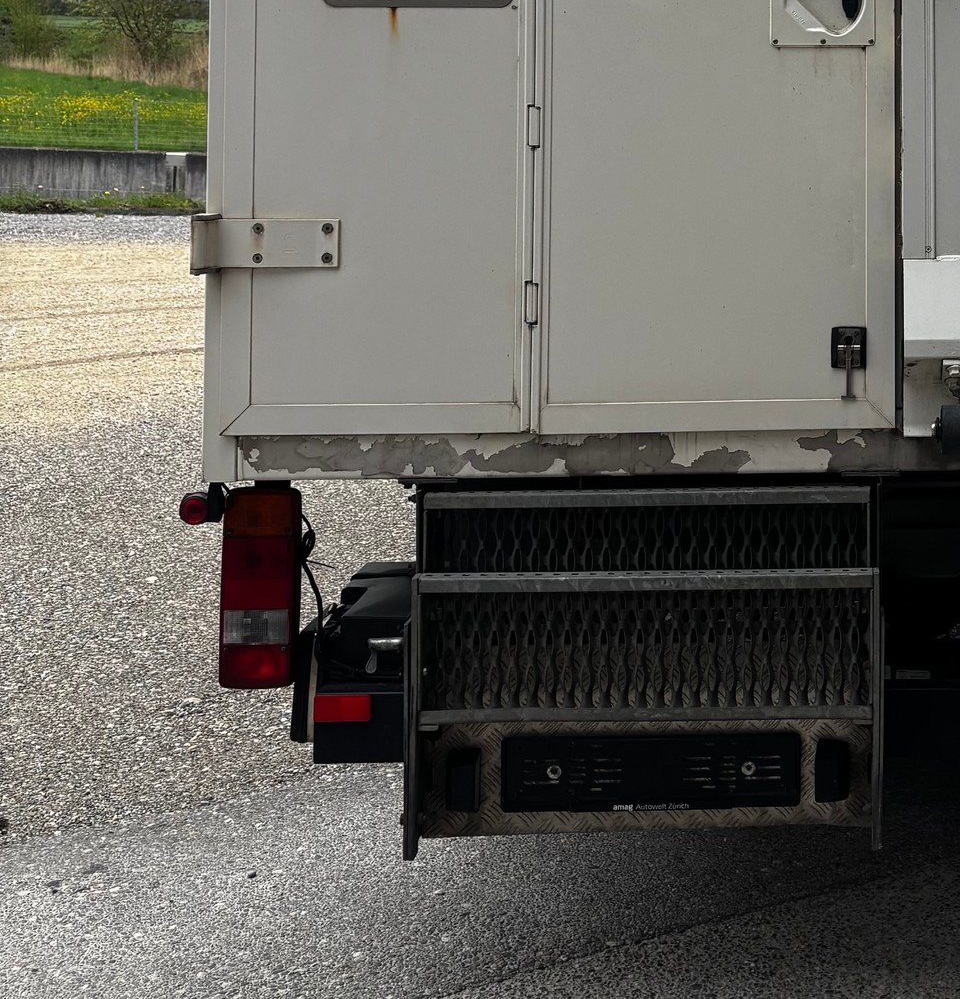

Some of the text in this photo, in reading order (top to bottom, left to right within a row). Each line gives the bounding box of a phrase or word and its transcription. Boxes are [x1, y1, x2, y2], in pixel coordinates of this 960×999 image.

[612, 802, 690, 812] amag Autowelt Zürich
